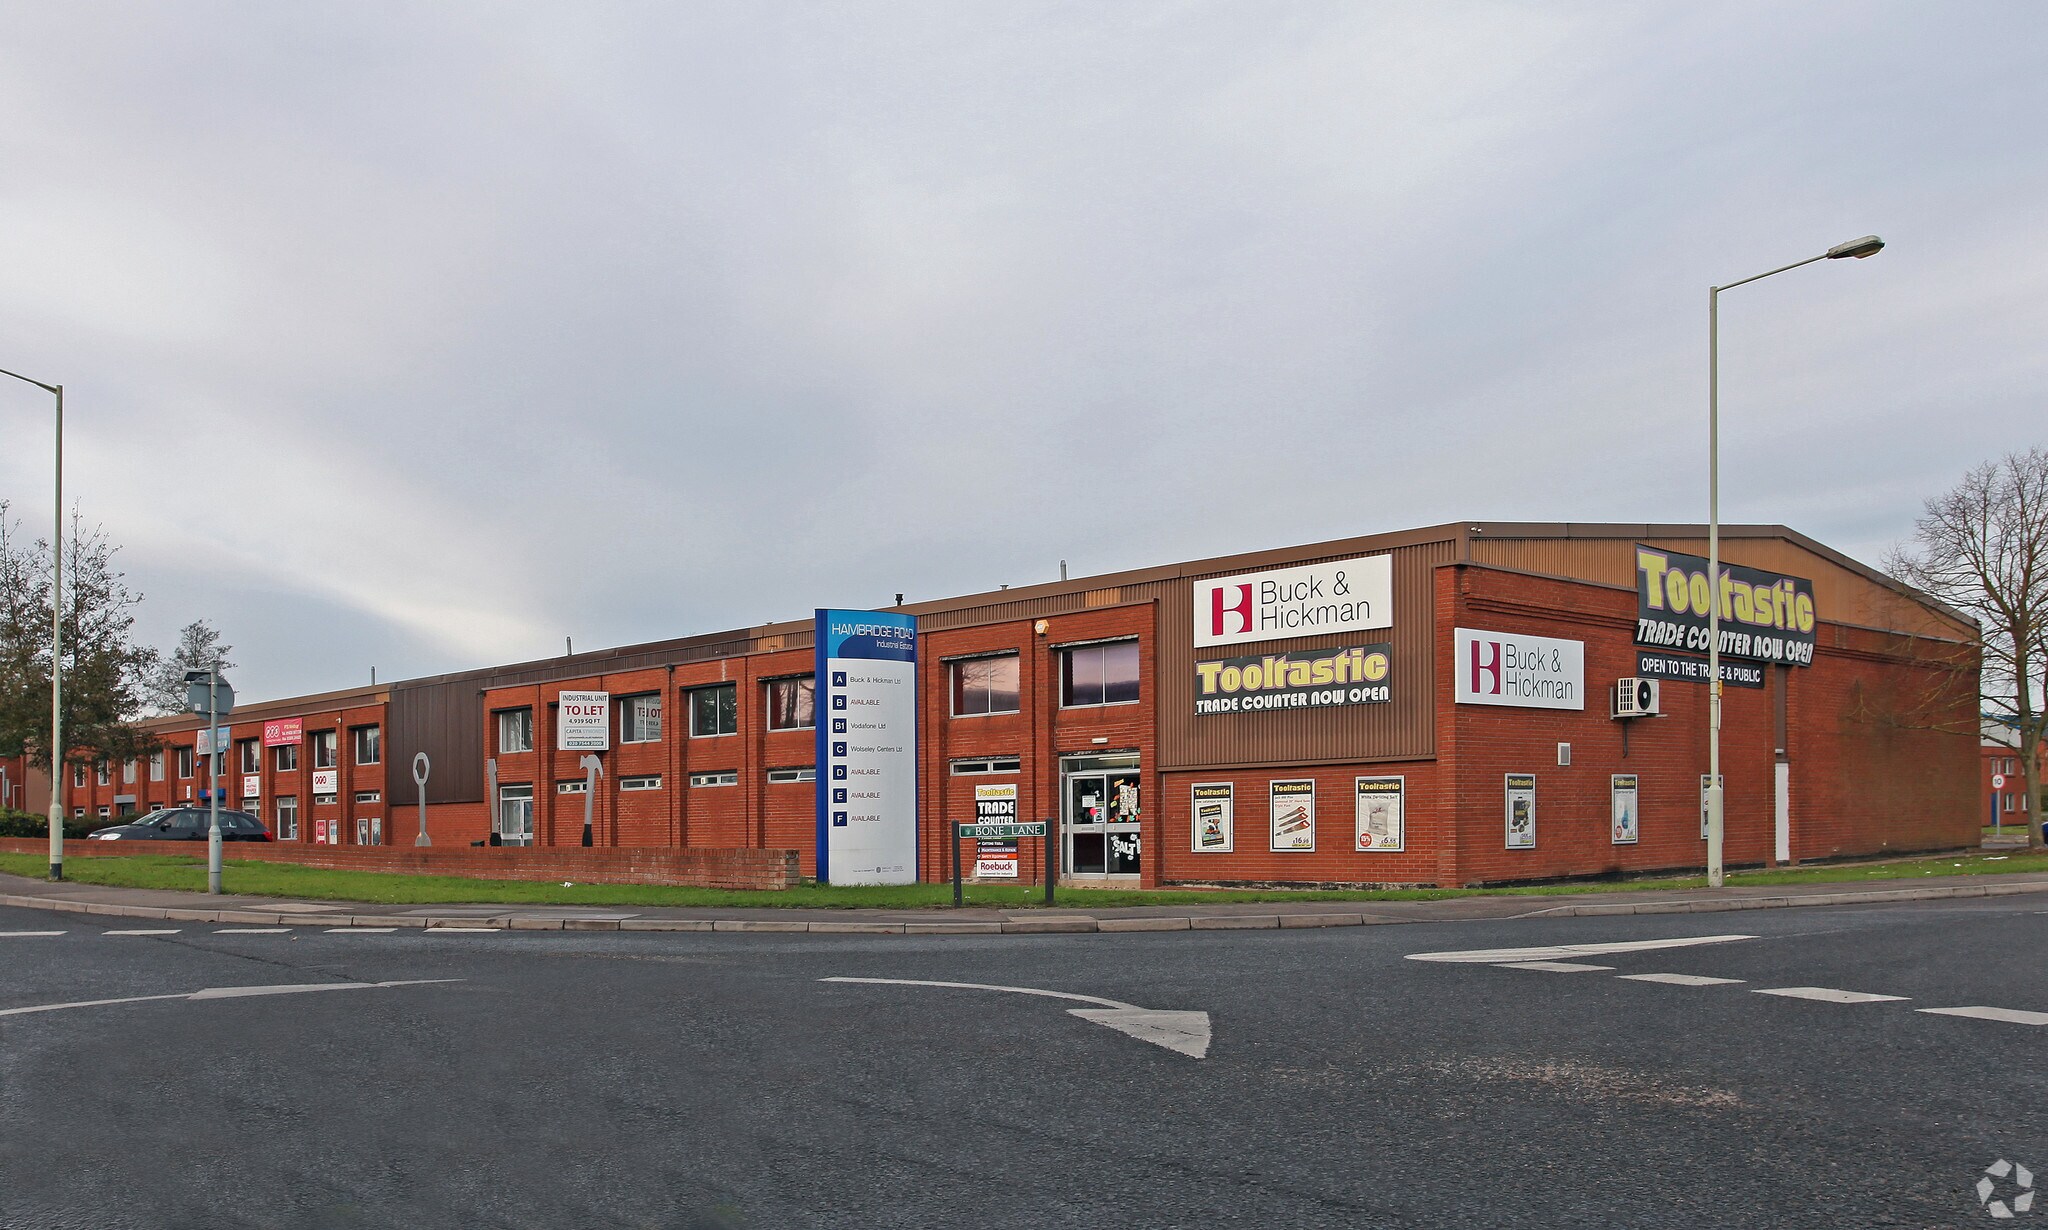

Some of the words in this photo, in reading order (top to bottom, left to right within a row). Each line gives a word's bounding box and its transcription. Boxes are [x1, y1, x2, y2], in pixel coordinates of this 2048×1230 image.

[1261, 575, 1323, 604] Buck
[1334, 571, 1350, 596] &
[1637, 549, 1815, 634] Tootastic
[1262, 600, 1370, 631] Hickman
[832, 623, 892, 638] HAMBRIDGE
[894, 627, 914, 640] ROAD
[876, 640, 899, 649] Industrial
[900, 642, 913, 651] Estate
[1637, 619, 1685, 646] TRADE
[1686, 626, 1751, 656] CONTER
[1753, 636, 1783, 660] NOW
[1785, 640, 1814, 664] OPEN
[1506, 644, 1546, 671] Buck
[1551, 648, 1562, 672] &
[1197, 648, 1389, 694] Tooltastic
[1642, 658, 1666, 674] OPEN
[1667, 660, 1679, 675] TO
[1680, 662, 1697, 676] THE
[1698, 664, 1724, 679] TRE
[1726, 667, 1732, 680] &
[1734, 668, 1761, 683] PUBLIC
[1506, 671, 1573, 700] Hickman
[1197, 698, 1238, 714] TRADE
[1242, 693, 1307, 710] COUNTER
[1311, 689, 1345, 704] NOW
[1349, 686, 1389, 702] OPEN
[565, 706, 580, 715] TO
[584, 706, 604, 715] LET
[835, 722, 845, 730] B1
[836, 746, 844, 754] C
[977, 788, 1014, 797] Tooltastic
[1274, 784, 1312, 792] Tooltastic
[837, 792, 843, 800] E
[978, 802, 1014, 815] TRADE
[837, 815, 843, 823] F
[978, 816, 1014, 825] COUNTER
[976, 827, 1004, 836] BONE
[1011, 825, 1040, 835] LANE
[1113, 840, 1136, 856] SALT
[981, 862, 1012, 870] Roebuck
